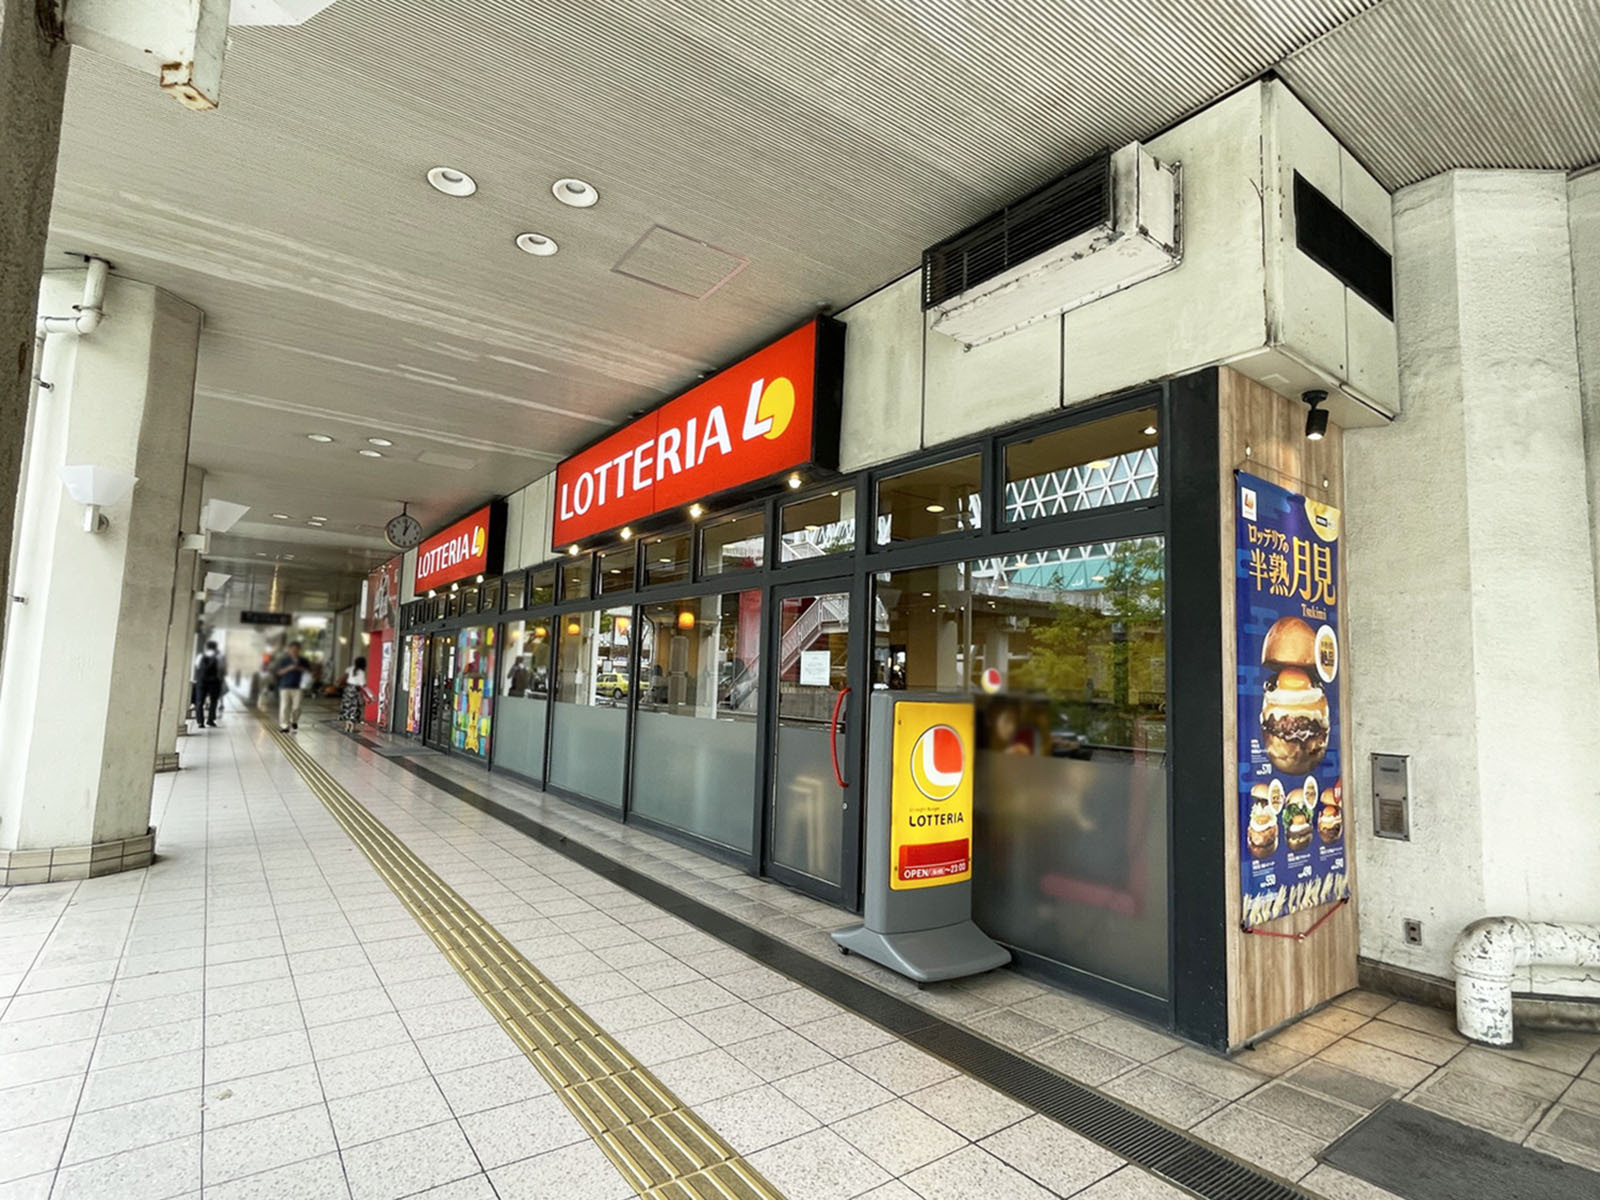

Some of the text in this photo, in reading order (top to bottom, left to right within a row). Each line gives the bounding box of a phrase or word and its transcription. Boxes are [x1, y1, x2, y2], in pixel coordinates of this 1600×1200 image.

[560, 405, 732, 521] LOTTERIA
[1247, 523, 1290, 554] ロッテリアの
[417, 538, 470, 578] LOTTERIA
[1249, 535, 1336, 606] 半熟月見
[1301, 603, 1327, 620] Tsukimi
[909, 812, 964, 827] LOTTERIA
[904, 868, 930, 879] OPEN
